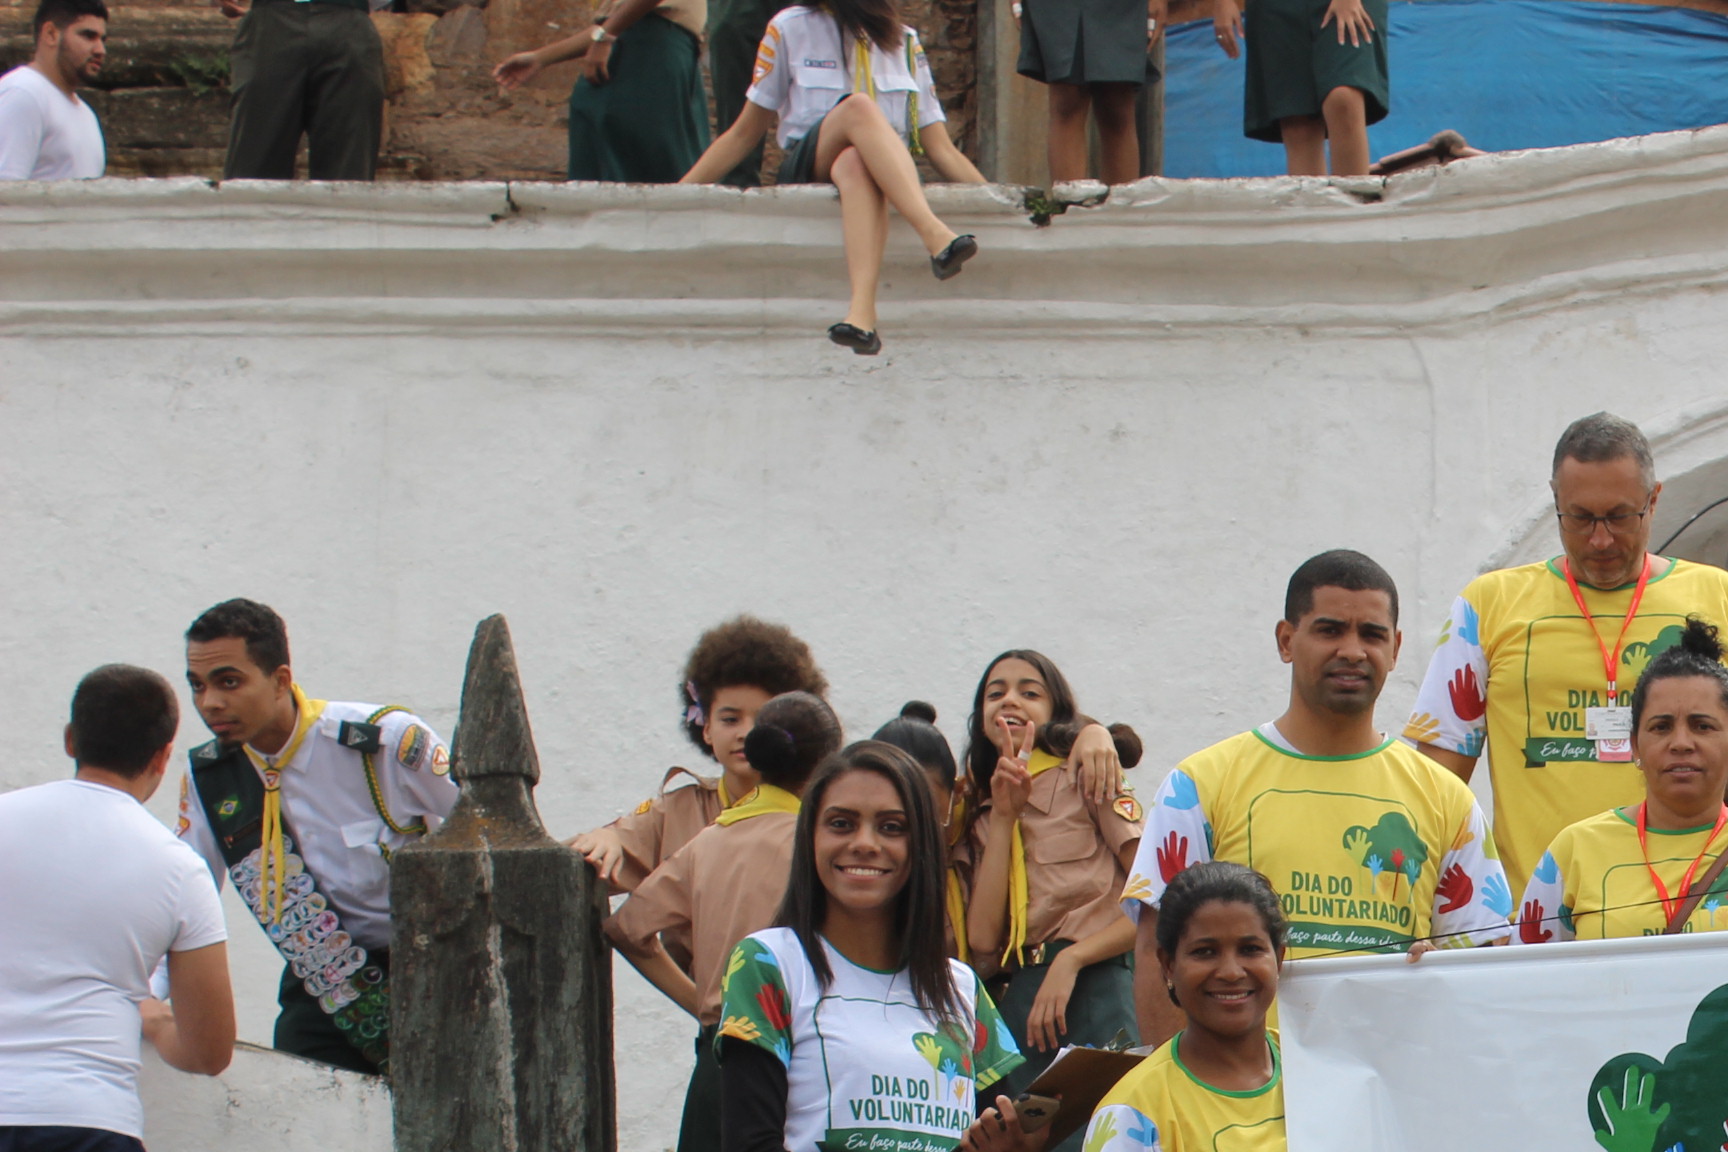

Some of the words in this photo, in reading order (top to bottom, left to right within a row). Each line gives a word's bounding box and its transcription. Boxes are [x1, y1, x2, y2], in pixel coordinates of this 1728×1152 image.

[1568, 690, 1600, 708] DIA
[1540, 742, 1560, 756] Eu
[1561, 743, 1586, 758] faço
[1292, 871, 1322, 893] DIA
[1328, 875, 1353, 896] DO
[1279, 893, 1411, 928] OLUNTARIADO
[1313, 932, 1343, 944] parte
[1345, 932, 1377, 945] dessa
[872, 1074, 902, 1097] DIA
[907, 1078, 929, 1101] DO
[850, 1099, 972, 1131] VOLUNTARIAD
[845, 1133, 867, 1149] Eu
[870, 1134, 895, 1151] faço
[897, 1138, 923, 1152] parte
